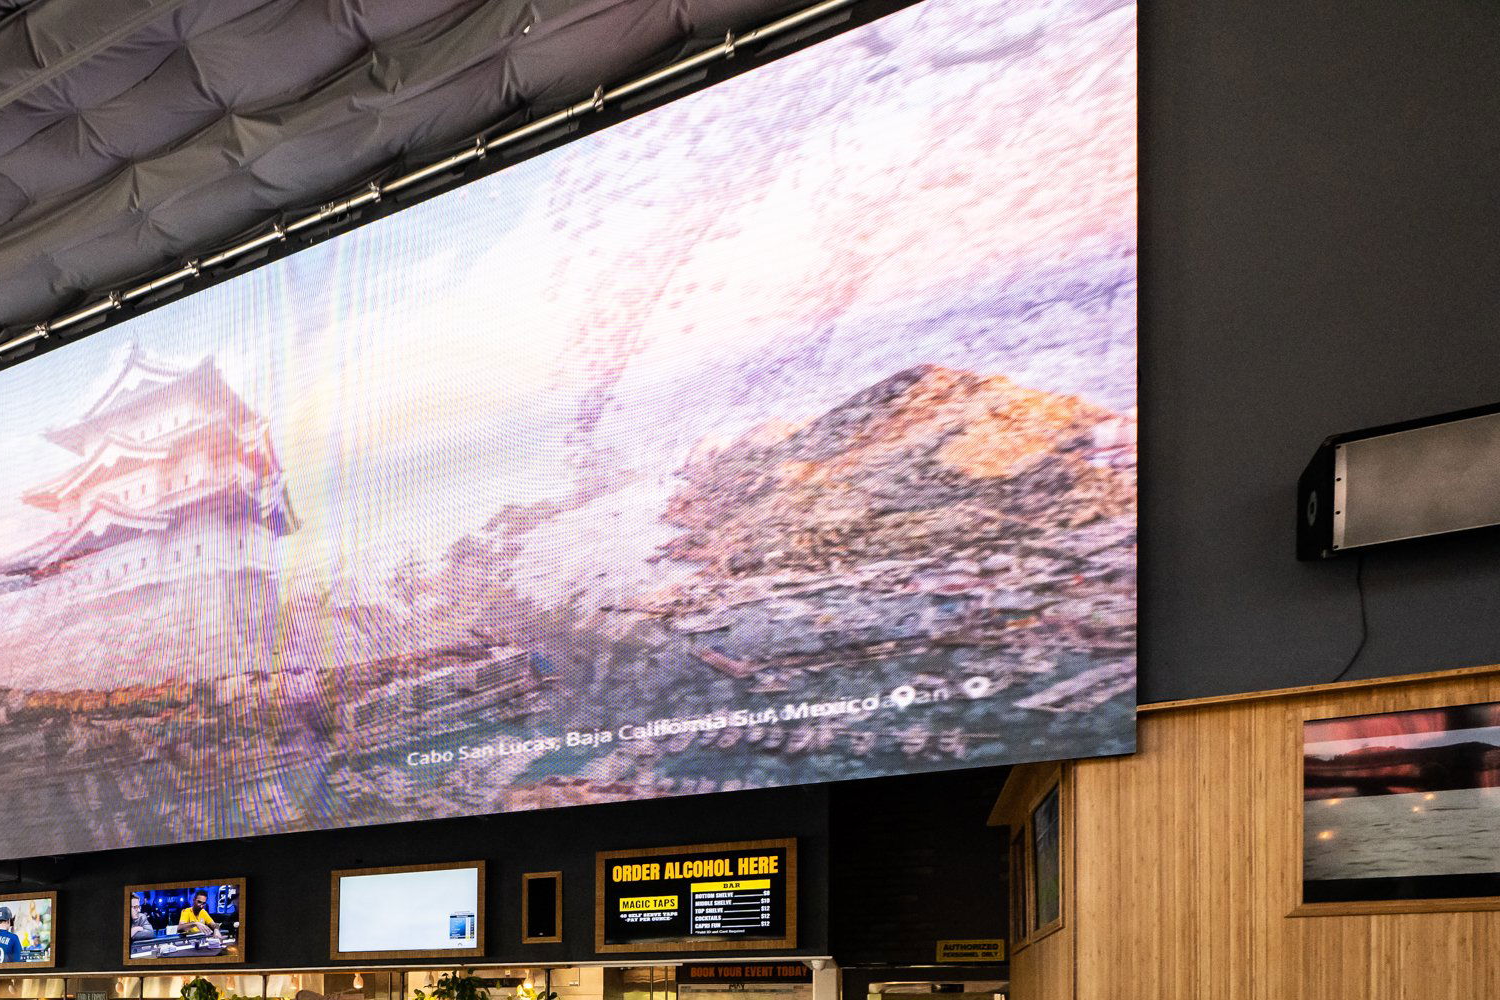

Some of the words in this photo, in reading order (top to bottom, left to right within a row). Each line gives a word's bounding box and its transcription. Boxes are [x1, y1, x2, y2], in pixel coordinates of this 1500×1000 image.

[407, 749, 454, 767] Cabo
[458, 744, 494, 761] San
[499, 737, 561, 757] Lucas,
[566, 729, 612, 748] Baja
[612, 863, 660, 882] ORDER
[664, 859, 733, 880] ALCOHOL
[738, 856, 778, 875] HERE
[622, 899, 651, 909] MAGIC
[653, 898, 676, 907] TAPS
[943, 943, 999, 951] AUTHORIZED
[690, 967, 715, 978] BOOK
[718, 966, 743, 977] YOUR
[745, 966, 773, 977] EVENT
[777, 965, 808, 977] TODAY
